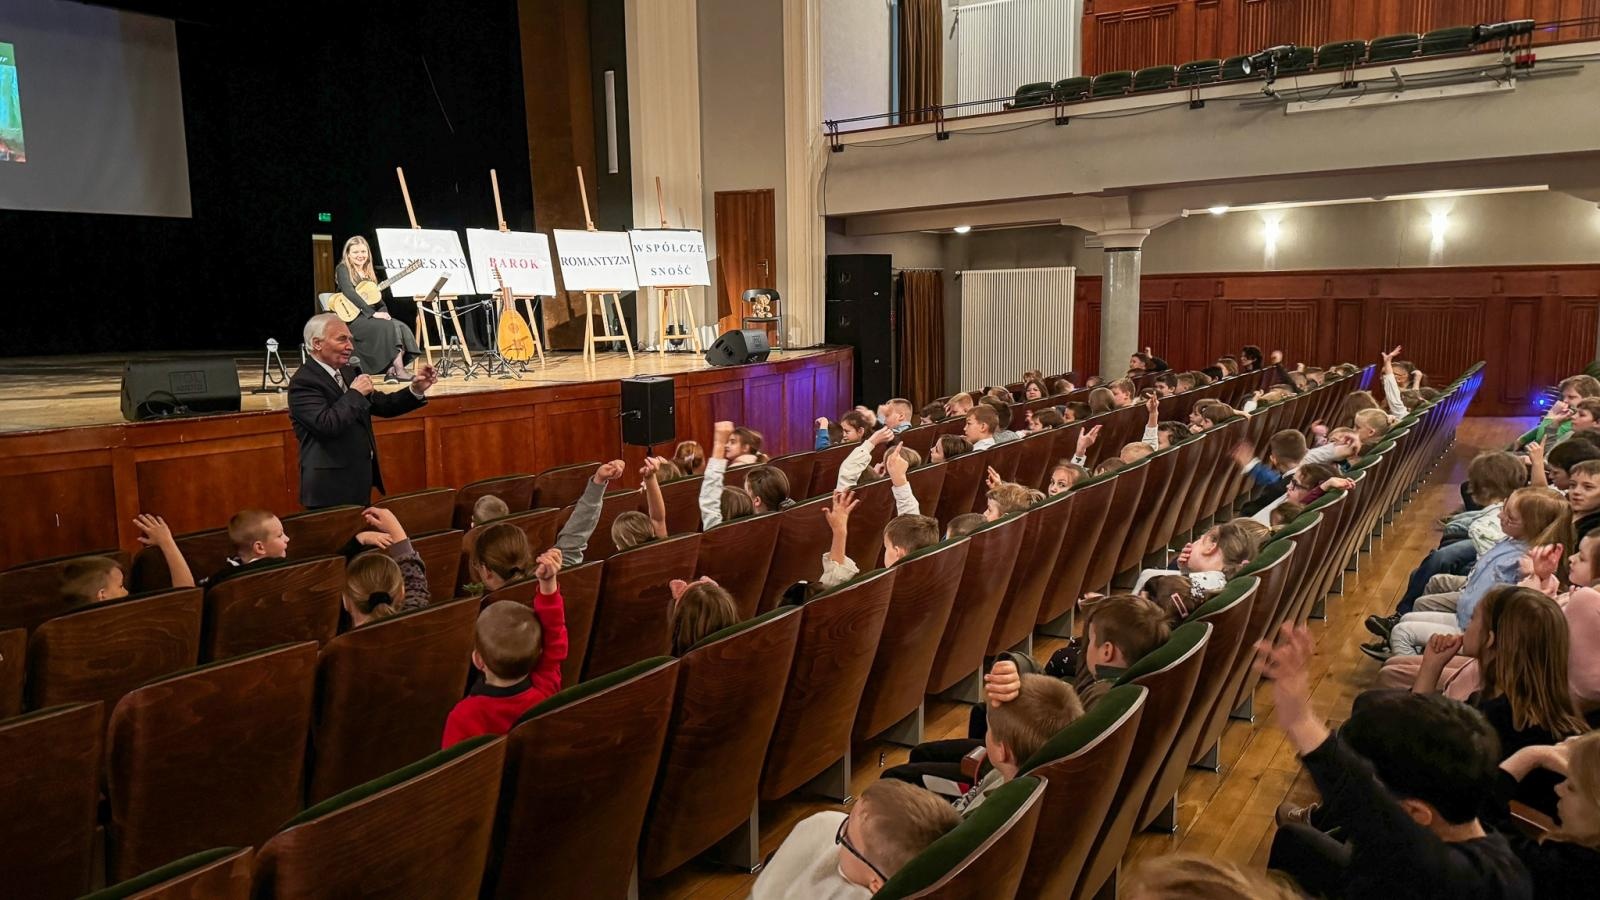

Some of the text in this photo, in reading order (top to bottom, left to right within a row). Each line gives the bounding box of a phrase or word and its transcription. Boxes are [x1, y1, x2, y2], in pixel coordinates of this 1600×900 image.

[489, 257, 539, 269] BAROK
[560, 255, 631, 267] ROMANTYZM
[650, 264, 692, 276] SNOŚĆ
